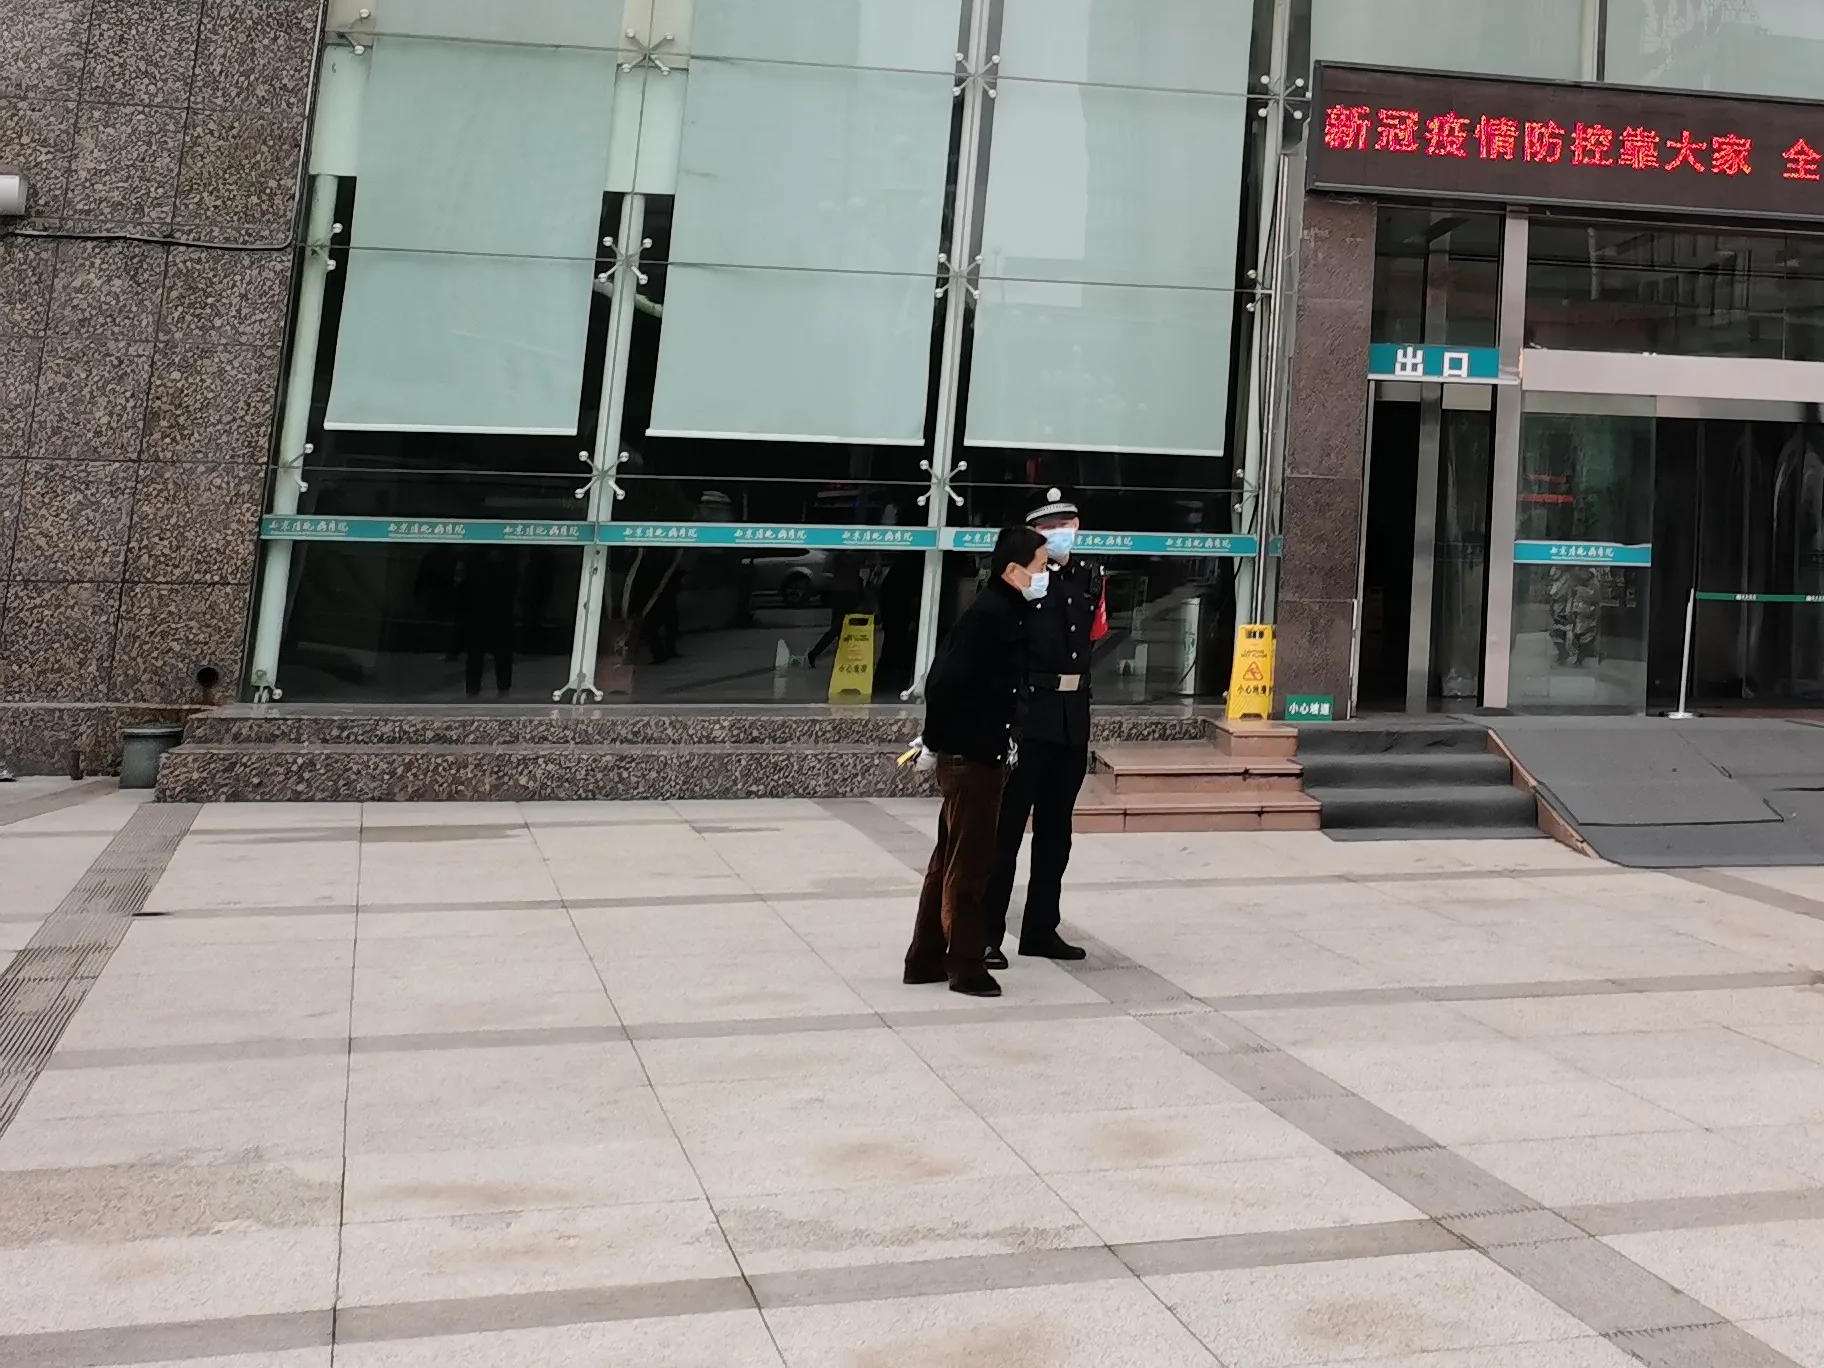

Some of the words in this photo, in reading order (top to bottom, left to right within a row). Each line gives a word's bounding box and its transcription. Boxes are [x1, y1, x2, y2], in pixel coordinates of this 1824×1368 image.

[1324, 104, 1752, 176] 新冠疫情防控靠大家
[1394, 346, 1469, 378] 出口
